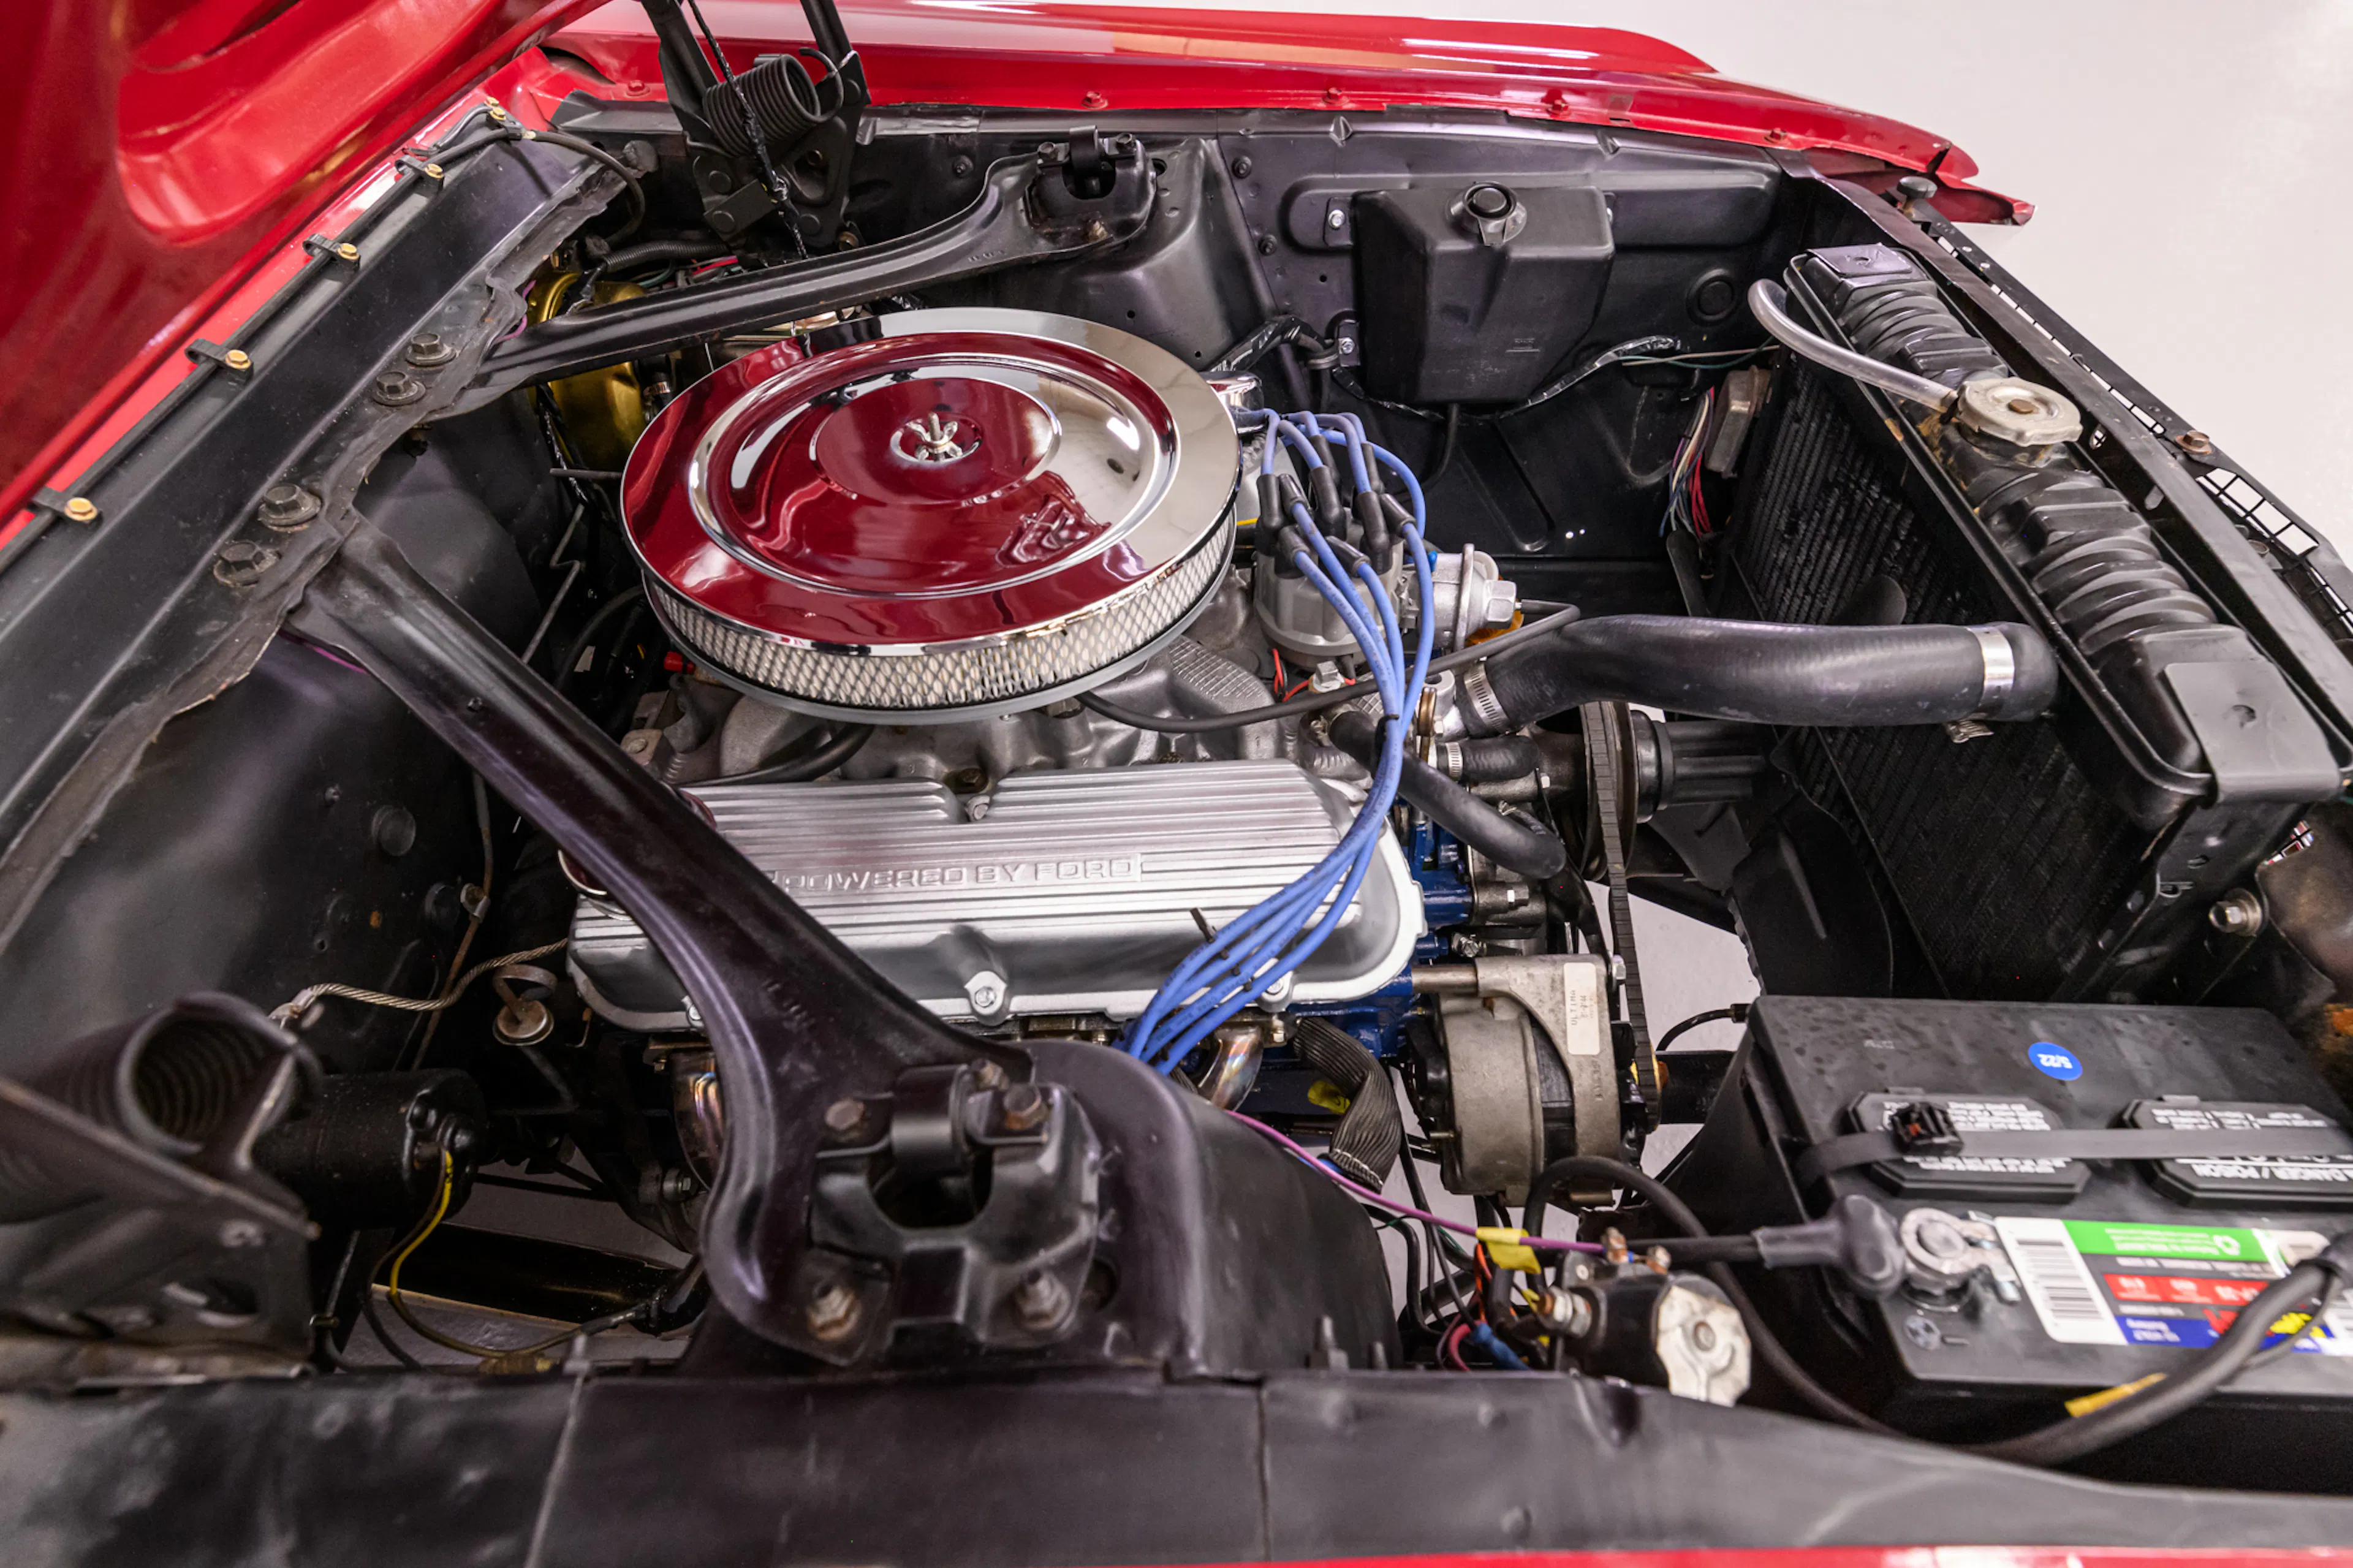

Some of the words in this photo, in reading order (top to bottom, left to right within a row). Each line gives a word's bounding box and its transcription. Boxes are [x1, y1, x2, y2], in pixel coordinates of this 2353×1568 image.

[782, 867, 967, 892] POWERED
[976, 863, 1026, 883] BY
[1034, 859, 1133, 881] FORD
